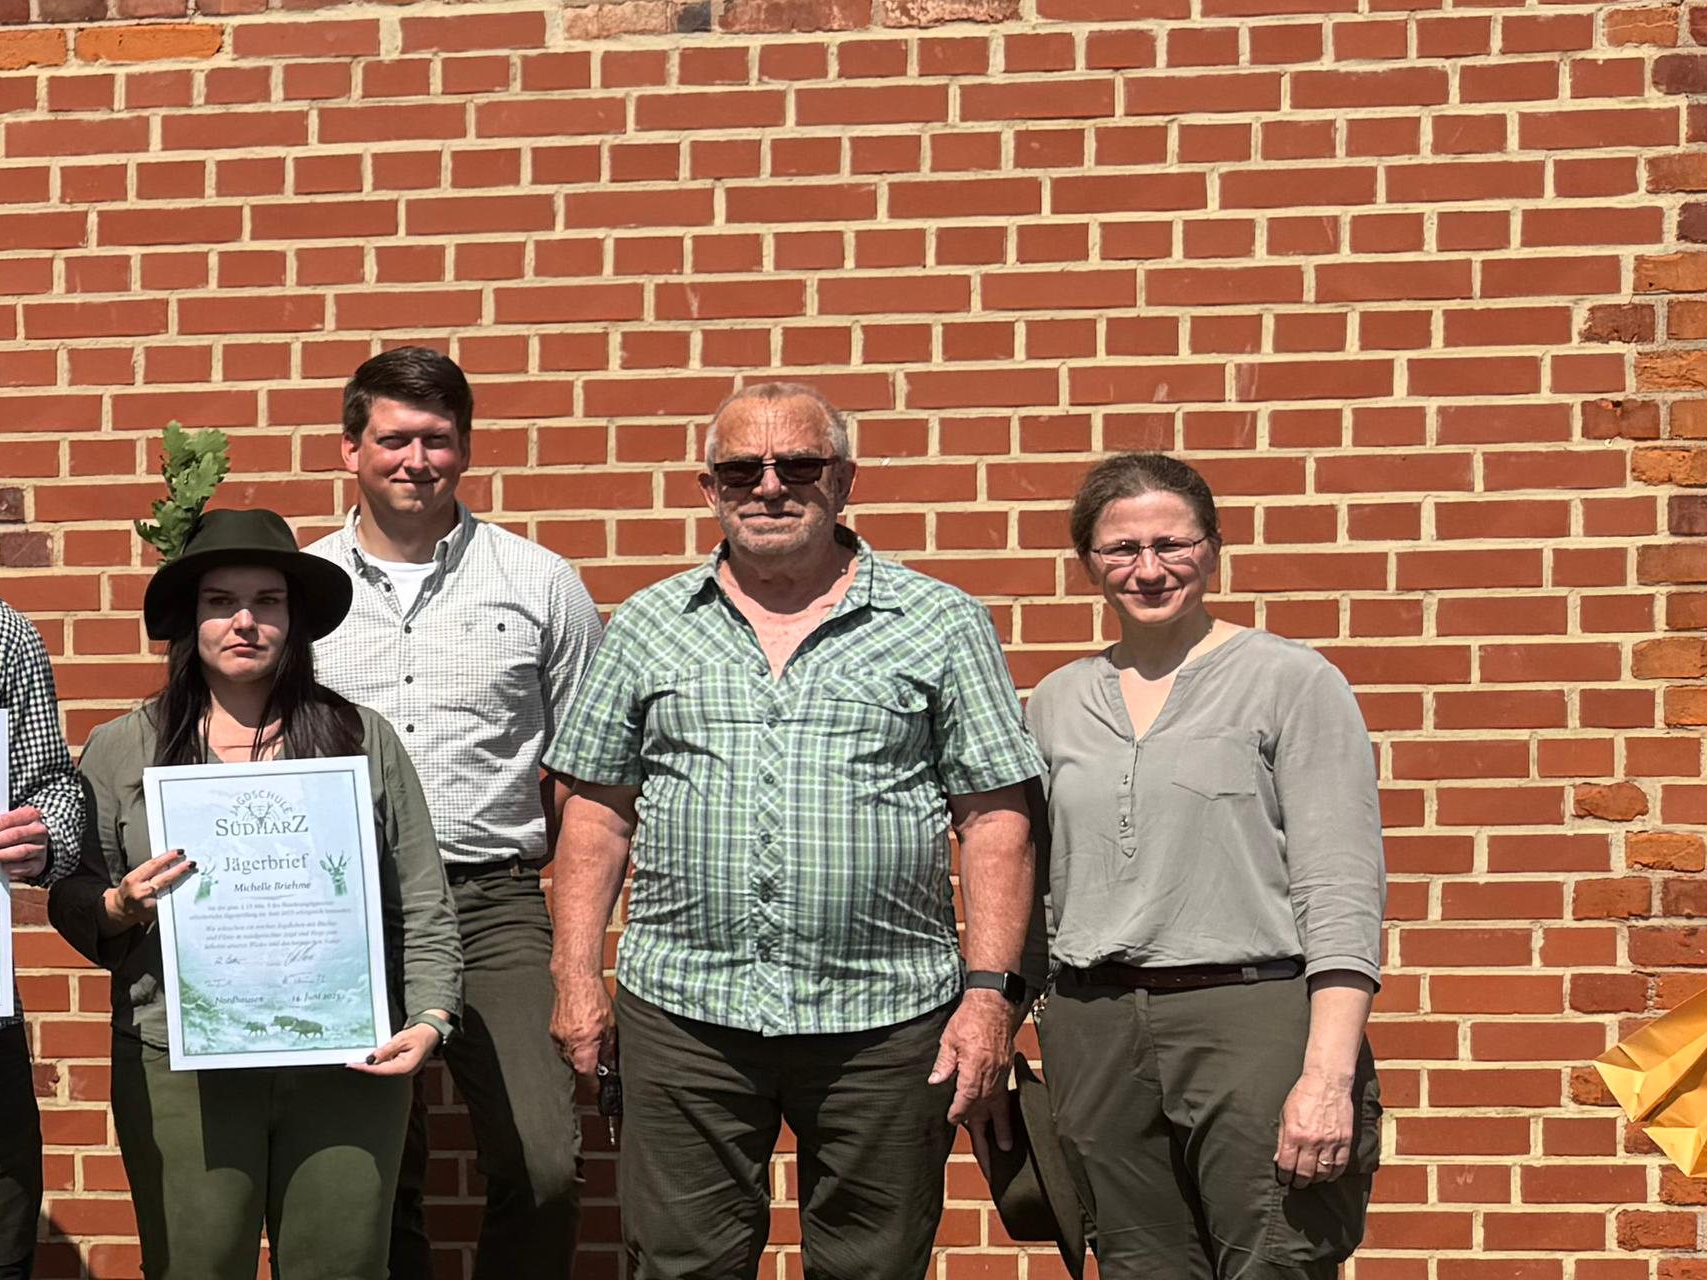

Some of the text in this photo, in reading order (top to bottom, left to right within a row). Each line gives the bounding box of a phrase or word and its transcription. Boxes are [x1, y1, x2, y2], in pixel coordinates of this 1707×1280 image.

[229, 789, 293, 817] JAGDSCHULE
[216, 815, 309, 837] SÜDHARZ
[223, 853, 310, 875] Jägerbrief
[234, 883, 272, 894] Michelle
